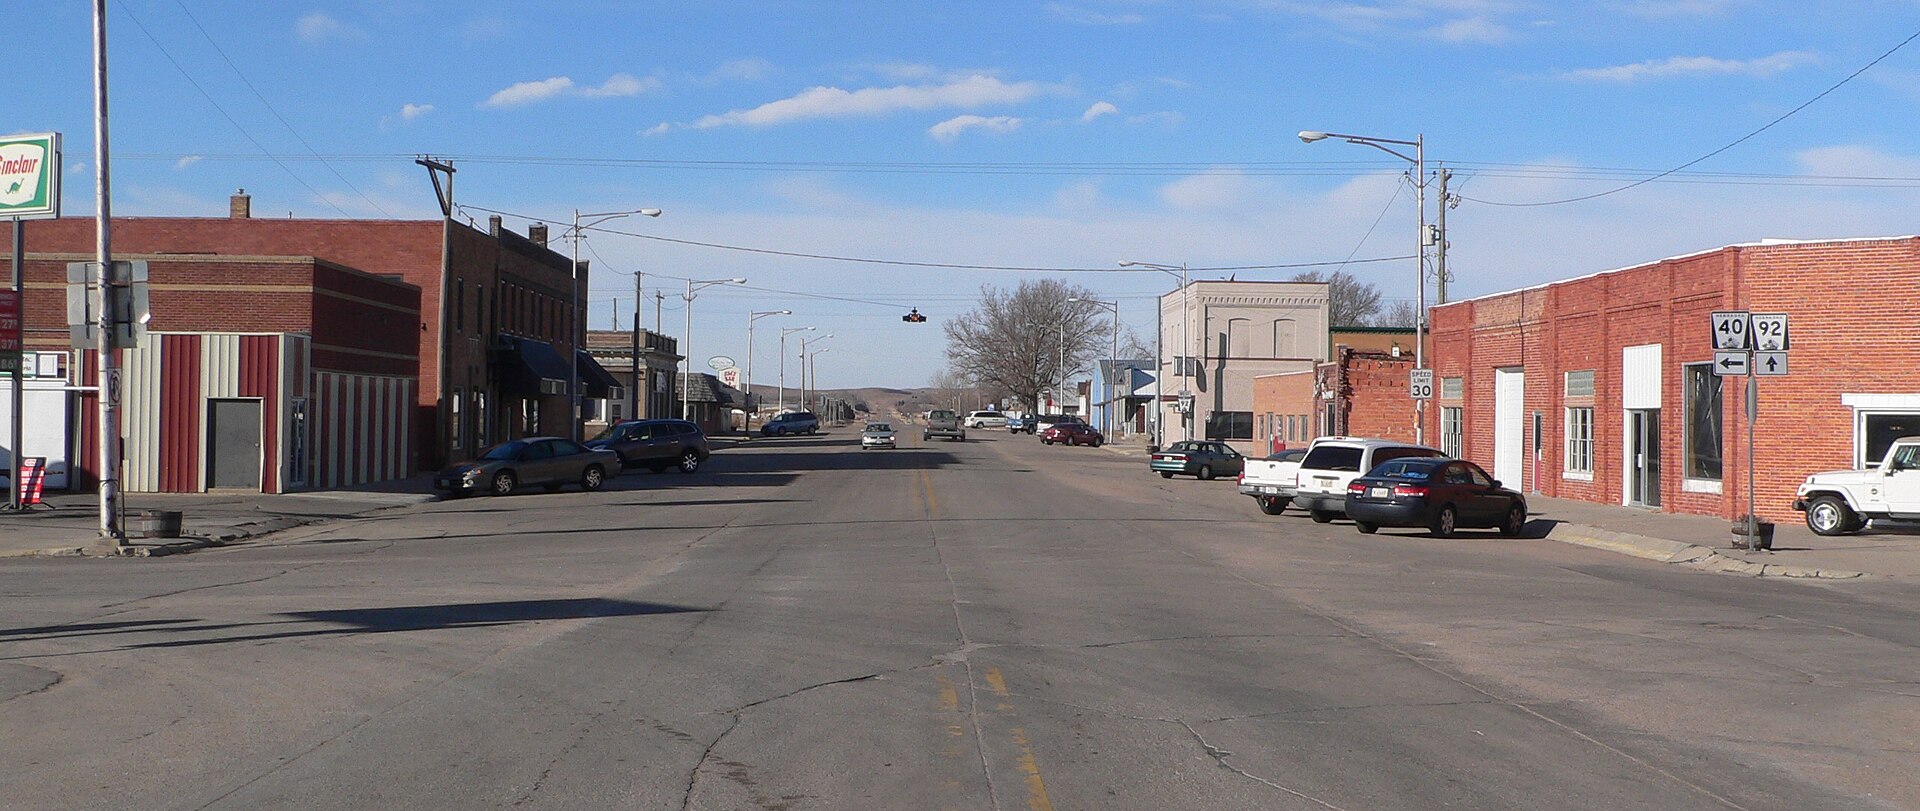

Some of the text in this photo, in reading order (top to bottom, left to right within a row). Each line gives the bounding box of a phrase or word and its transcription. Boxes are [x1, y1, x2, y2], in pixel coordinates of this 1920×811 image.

[1719, 319, 1742, 334] 40
[1759, 321, 1781, 336] 92
[1412, 385, 1431, 396] 30
